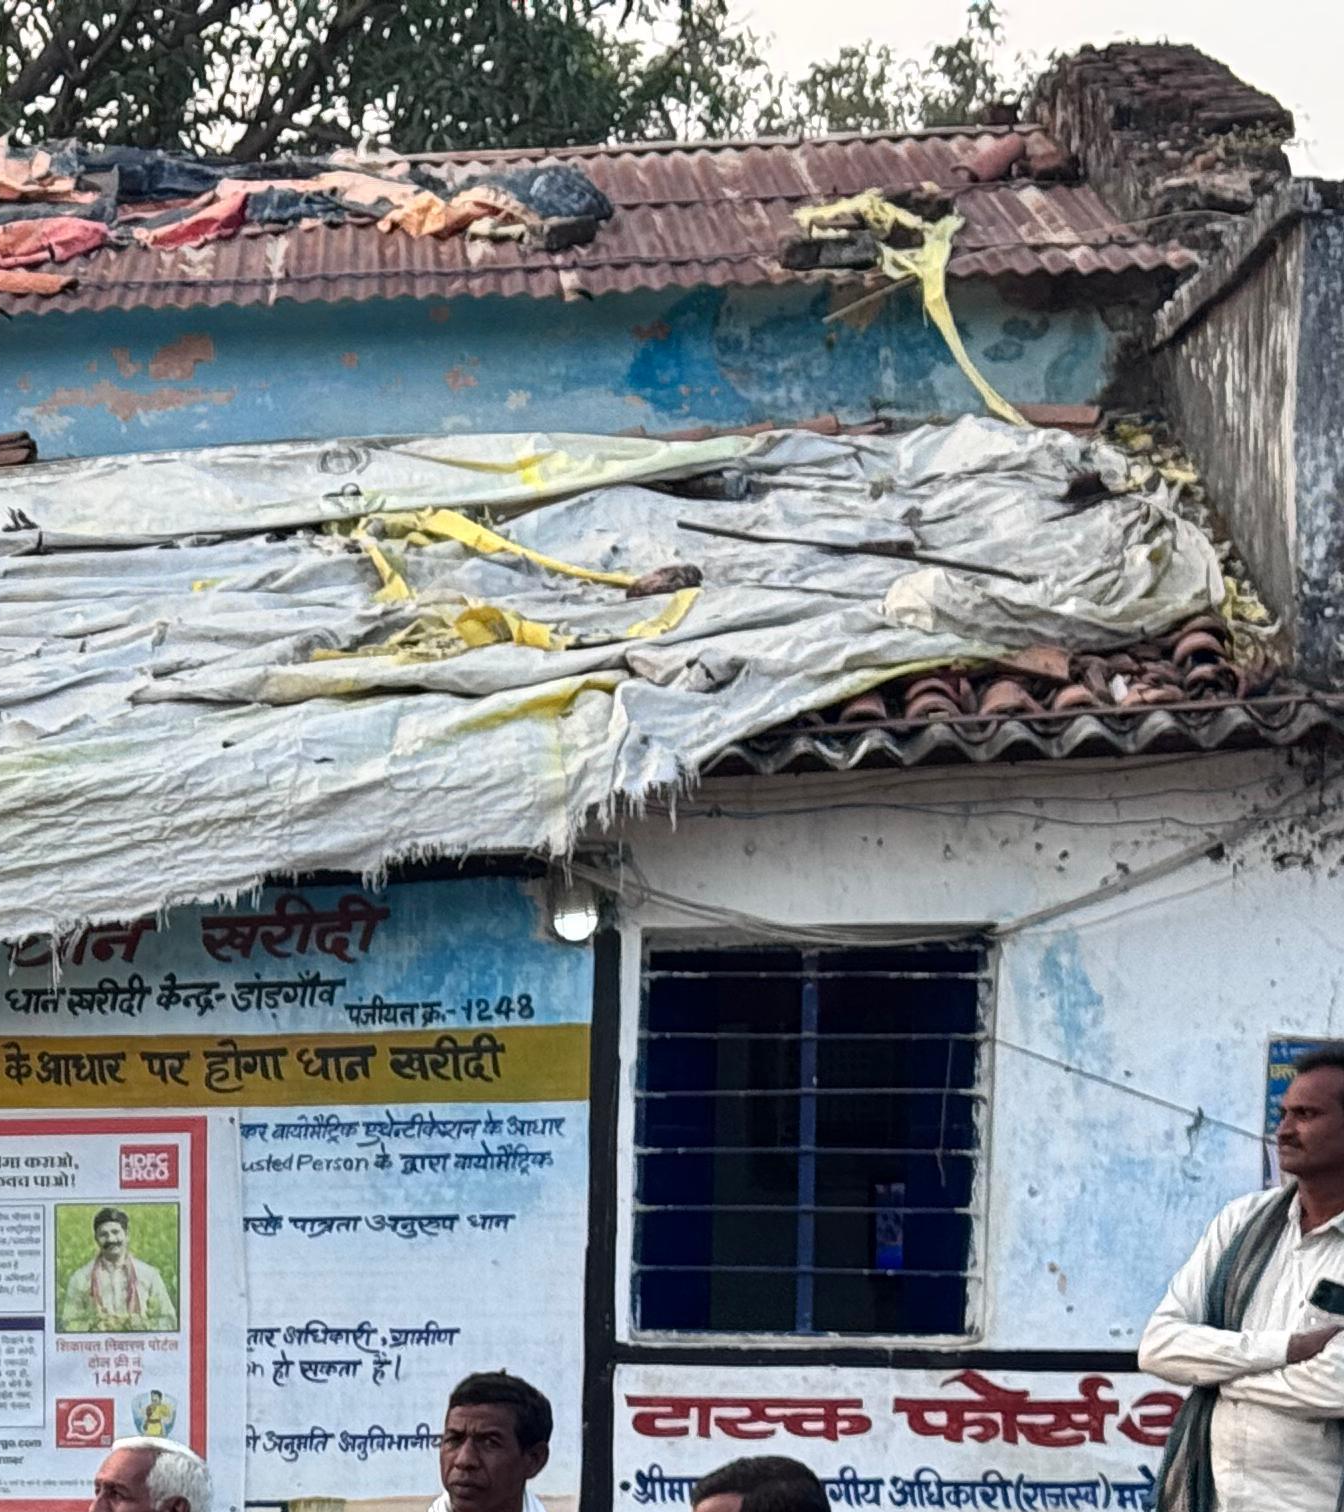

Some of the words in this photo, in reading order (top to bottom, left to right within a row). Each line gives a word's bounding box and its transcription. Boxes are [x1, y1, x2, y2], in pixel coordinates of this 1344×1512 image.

[202, 893, 389, 963] खरीदी
[5, 985, 60, 1015] धान
[67, 974, 151, 1016] खरीदी
[345, 994, 417, 1029] पंजीयन
[4, 1042, 35, 1084] के
[36, 1051, 125, 1086] आधार
[140, 1052, 190, 1086] पर
[204, 1040, 288, 1093] होगा
[297, 1046, 375, 1083] धान
[389, 1032, 505, 1081] खरीदी
[483, 1110, 504, 1138] के
[508, 1114, 567, 1138] आधार
[121, 1153, 168, 1167] HDFC
[121, 1165, 169, 1181] ERGO
[242, 1151, 294, 1172] usted
[297, 1153, 370, 1173] Person
[373, 1143, 394, 1172] के
[467, 1213, 516, 1233] धान
[93, 1370, 142, 1386] 14447
[272, 1352, 295, 1387] हो
[298, 1359, 362, 1384] सकता
[626, 1394, 872, 1442] टास्क
[893, 1369, 1119, 1448] फोर्स
[262, 1427, 334, 1463] अनुमति
[635, 1463, 696, 1508] श्रीमा
[888, 1467, 1012, 1510] अधिकारी
